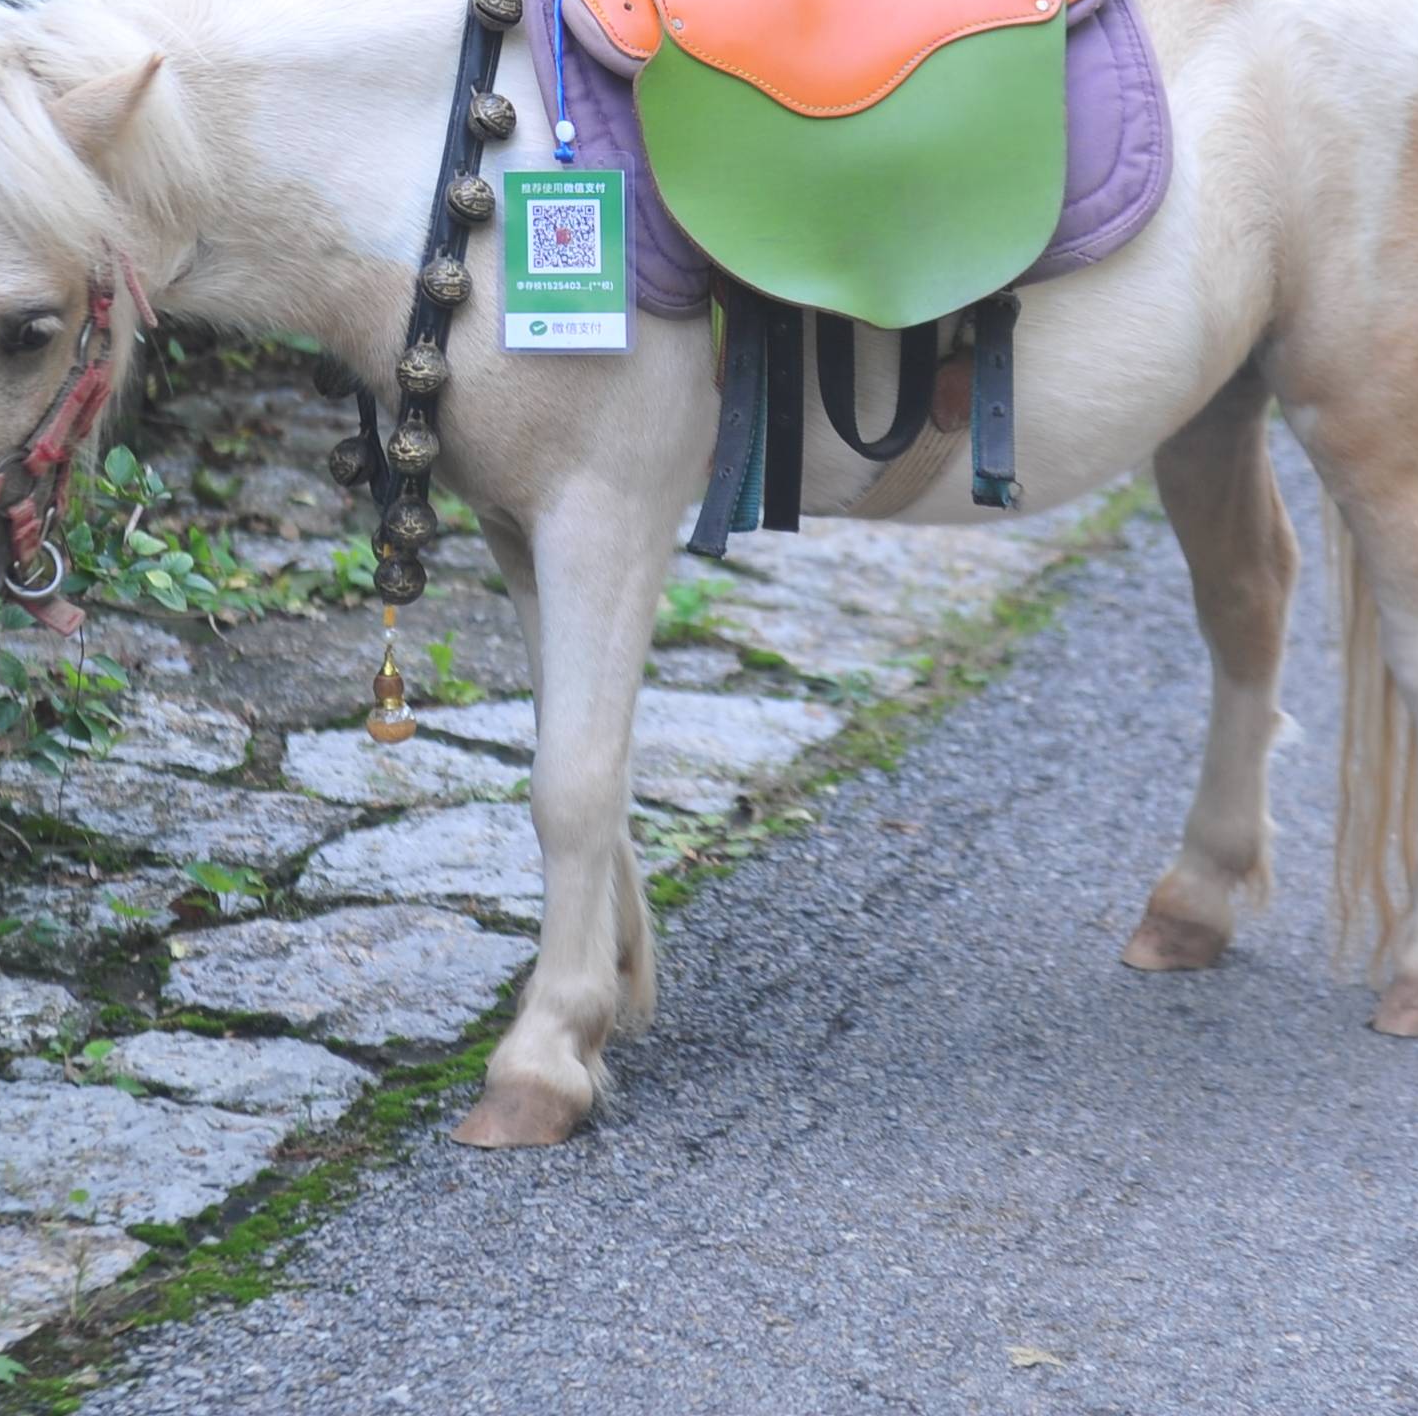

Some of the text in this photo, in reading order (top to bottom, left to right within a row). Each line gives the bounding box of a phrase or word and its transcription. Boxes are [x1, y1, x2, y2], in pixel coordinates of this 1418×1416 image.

[521, 182, 606, 194] 推荐使用微信支付
[551, 321, 602, 335] 微信支付
